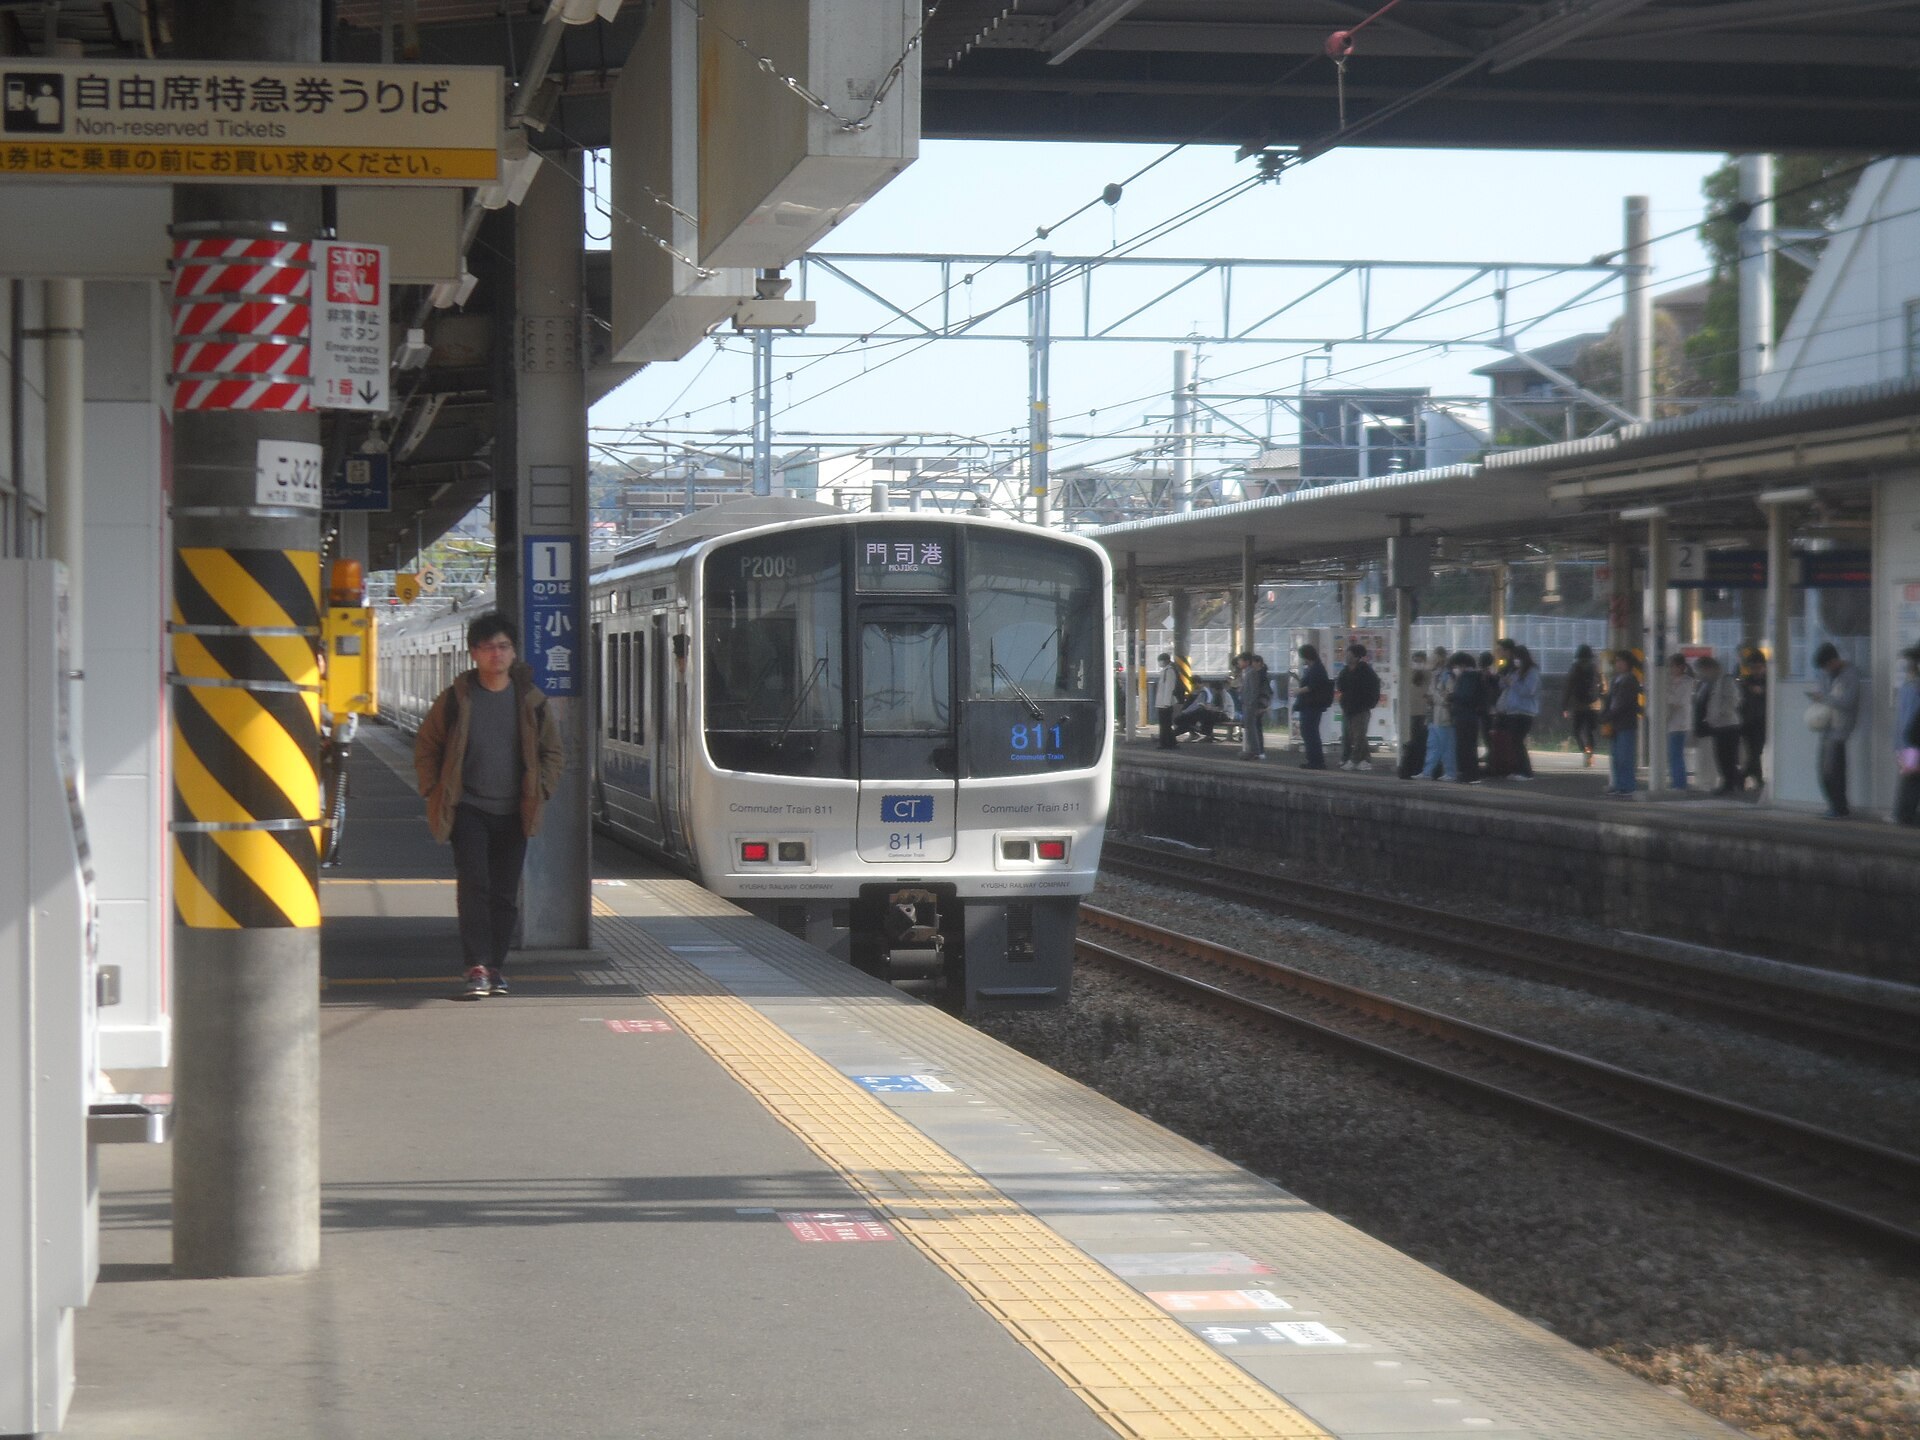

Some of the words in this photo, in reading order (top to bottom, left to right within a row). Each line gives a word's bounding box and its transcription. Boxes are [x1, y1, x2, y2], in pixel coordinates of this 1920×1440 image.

[76, 74, 450, 115] 自由席特急券うりば
[75, 117, 209, 137] Non-reserved
[216, 119, 286, 138] Tickets
[0, 146, 443, 176] 券はご乗車の前にお買い求めください。
[331, 250, 377, 267] STOP
[327, 309, 380, 325] 非常停止
[340, 327, 380, 341] ボタン
[545, 546, 557, 577] 1
[866, 543, 943, 565] 門司港
[1680, 546, 1692, 568] 2
[741, 556, 797, 578] P2009
[425, 571, 434, 585] 6
[532, 581, 571, 595] のりば
[545, 610, 572, 671] 小倉
[545, 676, 572, 689] 方面
[1011, 723, 1061, 749] 811
[1010, 753, 1045, 761] Commuter
[729, 803, 783, 814] Commuter
[786, 804, 812, 814] Train
[814, 805, 833, 814] 811
[893, 800, 921, 818] CT
[982, 804, 1034, 813] Commuter
[1036, 803, 1060, 812] Train
[1062, 803, 1080, 812] 811
[889, 833, 924, 850] 811
